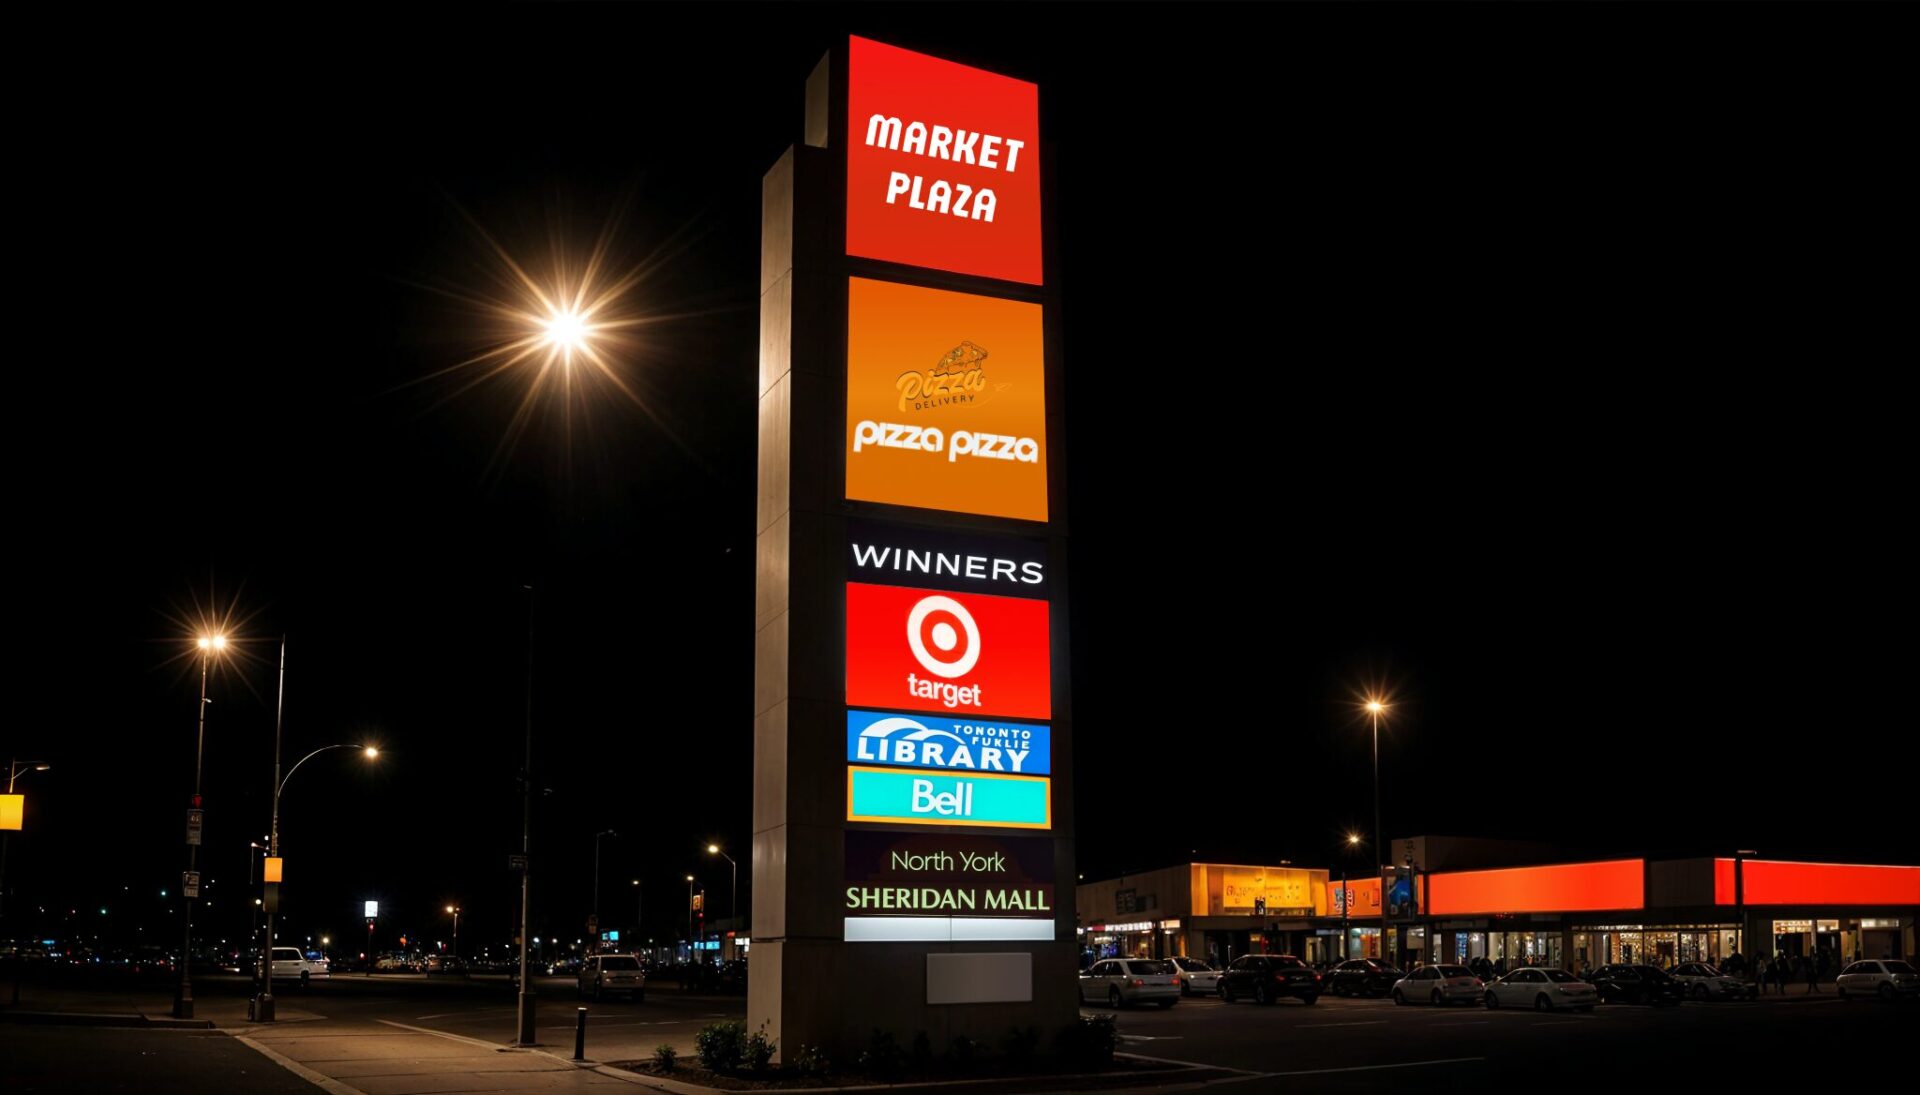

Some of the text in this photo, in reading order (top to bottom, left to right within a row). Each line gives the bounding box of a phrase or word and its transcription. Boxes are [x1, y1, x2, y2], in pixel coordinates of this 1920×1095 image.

[865, 113, 1024, 172] MARKET
[886, 171, 997, 223] PLAZA
[915, 395, 975, 410] DELIVERY
[853, 420, 1039, 463] pizza pizza
[852, 543, 1044, 584] WINNERS
[907, 673, 982, 708] target
[953, 725, 1031, 739] TONONTO
[857, 736, 1030, 772] LIBRARY
[911, 779, 973, 816] Bell
[891, 850, 1006, 872] North York
[846, 887, 1050, 911] SHERIDAN MALL
